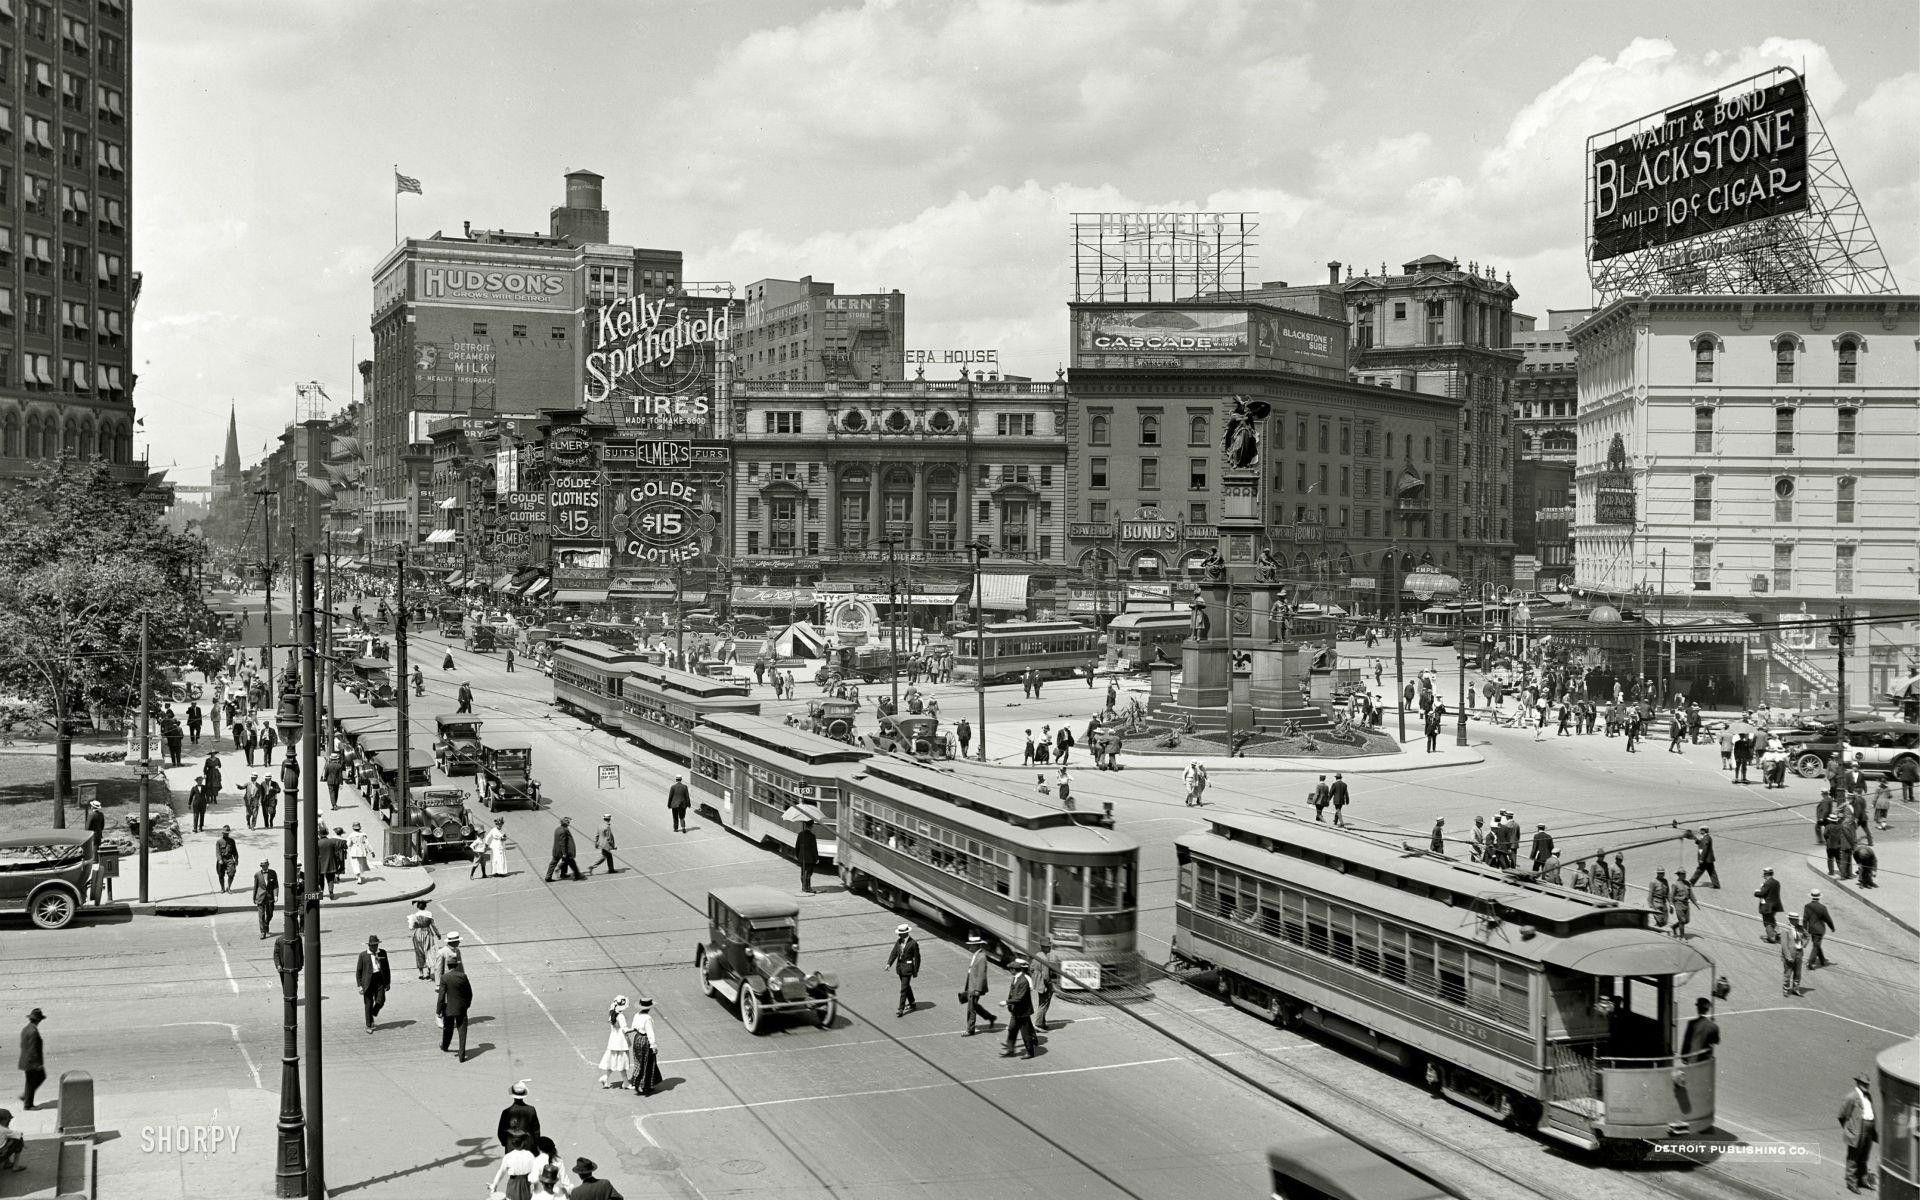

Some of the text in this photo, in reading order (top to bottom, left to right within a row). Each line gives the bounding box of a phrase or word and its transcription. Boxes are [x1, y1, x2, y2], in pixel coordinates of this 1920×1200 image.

[1631, 89, 1766, 151] WAITT & BOND
[1595, 109, 1795, 219] BLACKSTONE
[1621, 207, 1659, 229] MILD
[1707, 168, 1802, 214] CIGAR
[1123, 241, 1211, 263] FLOUR
[1658, 253, 1676, 270] LEE
[1689, 246, 1720, 262] CADY
[425, 268, 564, 298] HUDSON'S
[452, 289, 488, 299] GROWS
[825, 299, 890, 310] KERN'S
[1095, 337, 1211, 348] CASCADE
[1283, 328, 1327, 344] BLACKSTONE
[453, 342, 490, 352] DETROIT
[584, 306, 730, 402] Springfield
[1309, 342, 1327, 352] SURE
[448, 352, 496, 362] CREAMERY
[944, 350, 996, 363] HOUSE
[454, 362, 489, 374] MILK
[628, 395, 709, 415] TIRES
[550, 441, 589, 450] ELMER'S
[605, 449, 635, 457] SUITS
[639, 442, 689, 466] ELMER'S
[557, 478, 591, 488] GOLDE
[510, 493, 545, 504] GOLDE
[551, 491, 599, 507] CLOTHES
[630, 481, 697, 502] GOLDE
[510, 511, 546, 521] CLOTHES
[560, 510, 589, 531] $15
[642, 514, 682, 534] $15
[496, 533, 530, 544] ELMER'S
[1123, 524, 1175, 540] BOND'S
[627, 541, 700, 564] CLOTHES
[1449, 1017, 1487, 1040] 7126
